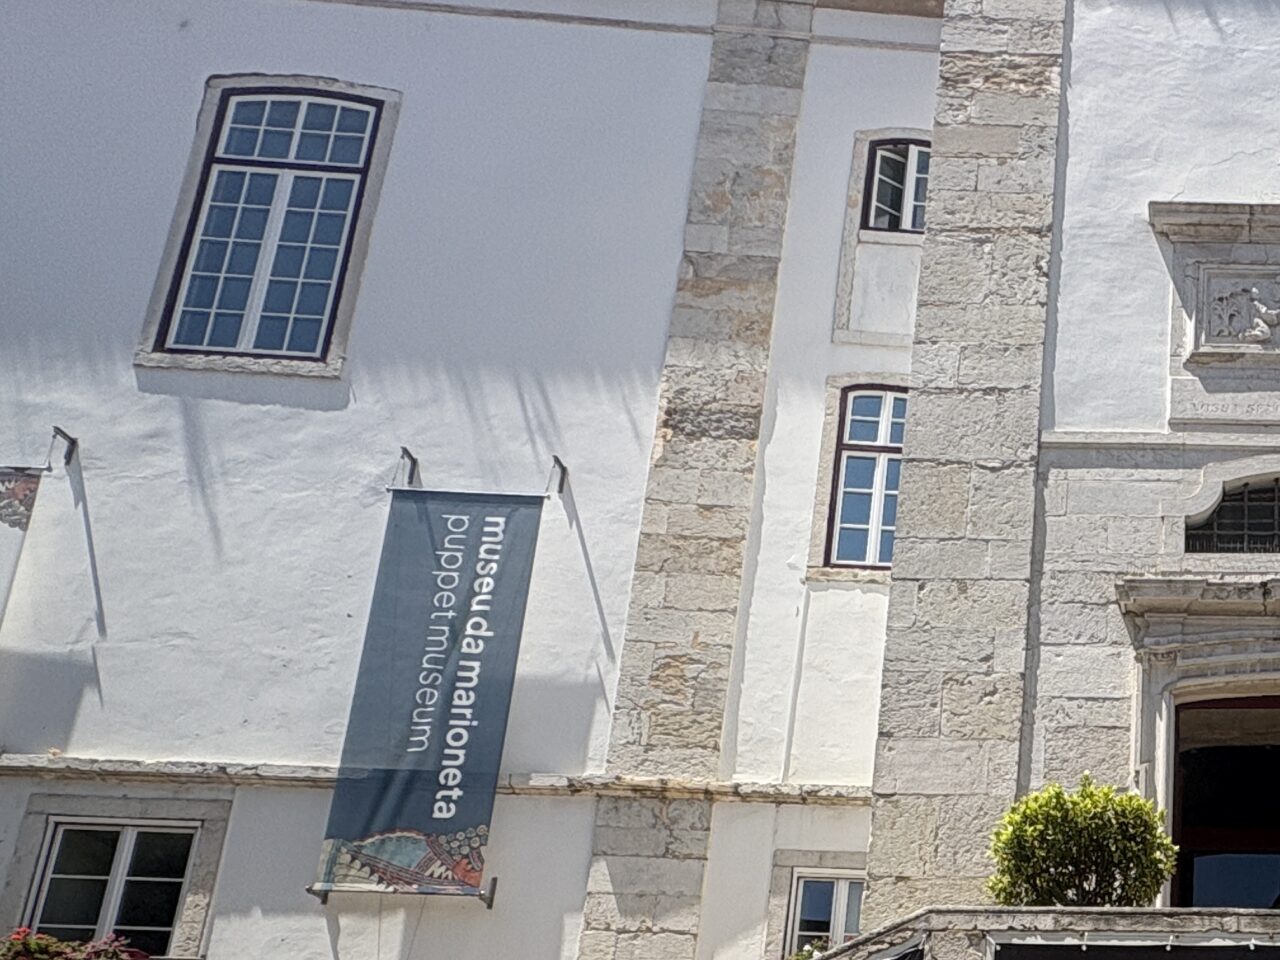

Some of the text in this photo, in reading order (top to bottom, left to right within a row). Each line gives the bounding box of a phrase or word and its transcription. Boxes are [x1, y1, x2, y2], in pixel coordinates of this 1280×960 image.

[406, 514, 470, 752] puppet museum
[432, 516, 507, 819] museu da marioneta
